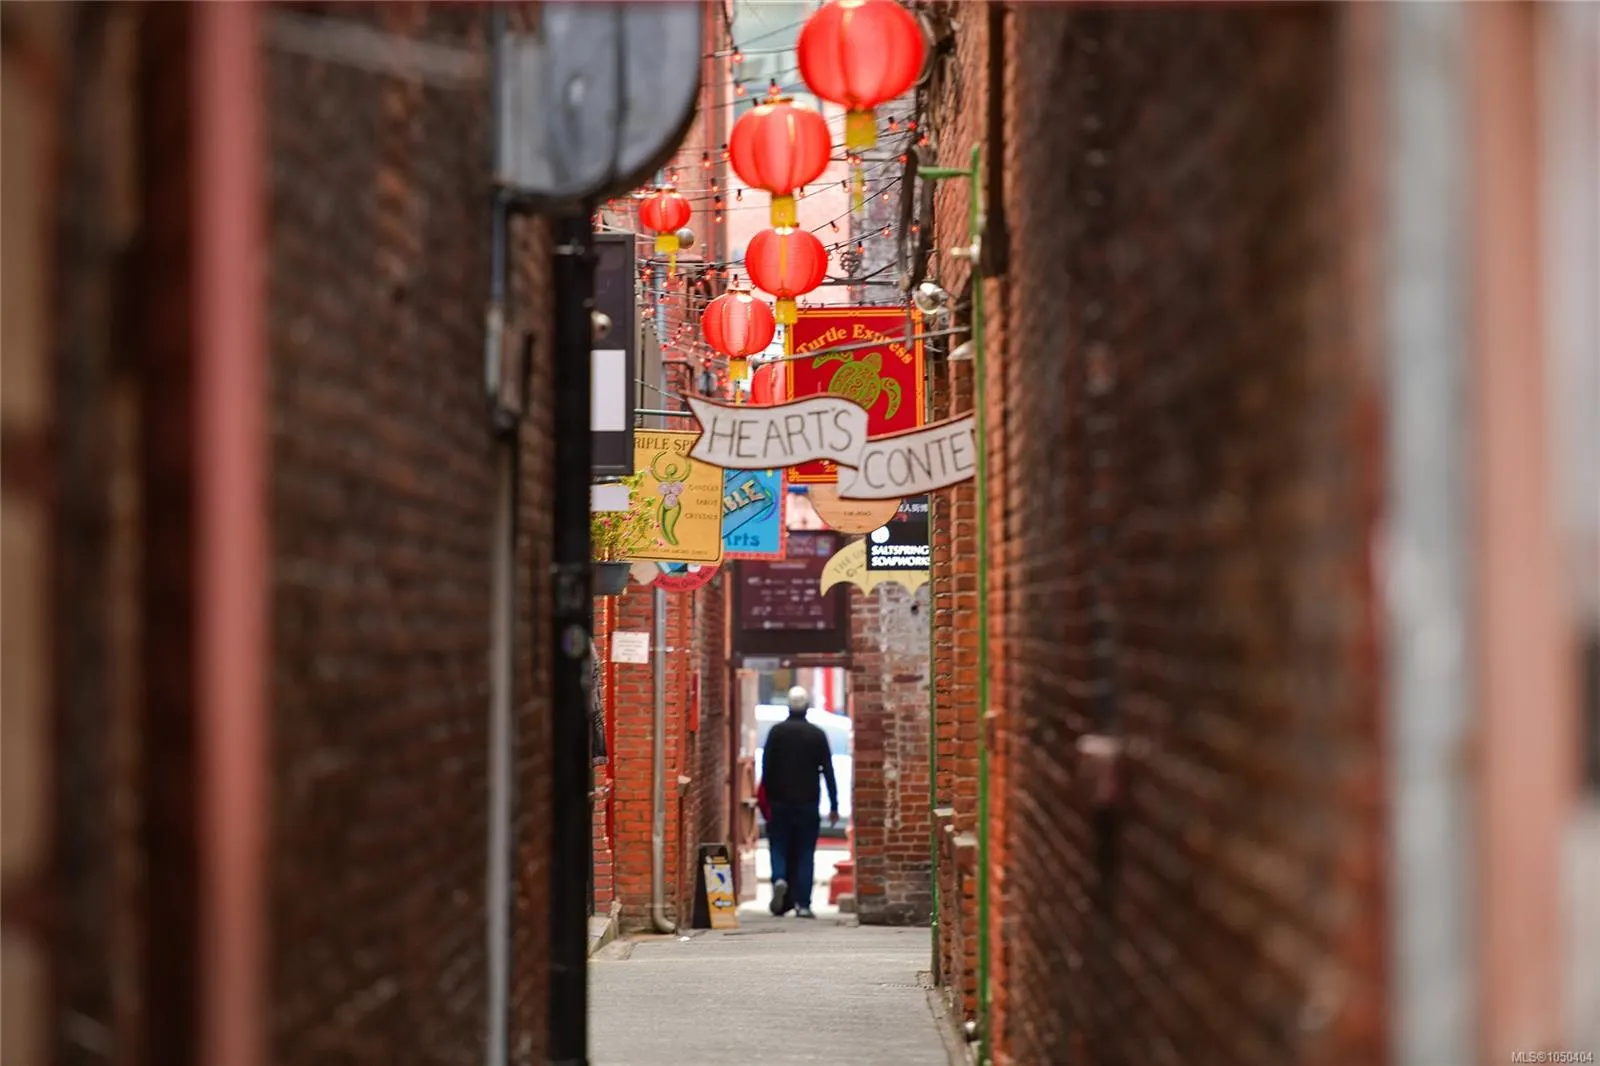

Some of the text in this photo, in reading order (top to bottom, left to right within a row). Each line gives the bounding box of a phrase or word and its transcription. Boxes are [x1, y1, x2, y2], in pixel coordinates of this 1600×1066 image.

[796, 324, 913, 364] Turtle Express
[708, 407, 975, 489] HEART'S CONTE
[871, 545, 929, 556] SALTSPRING
